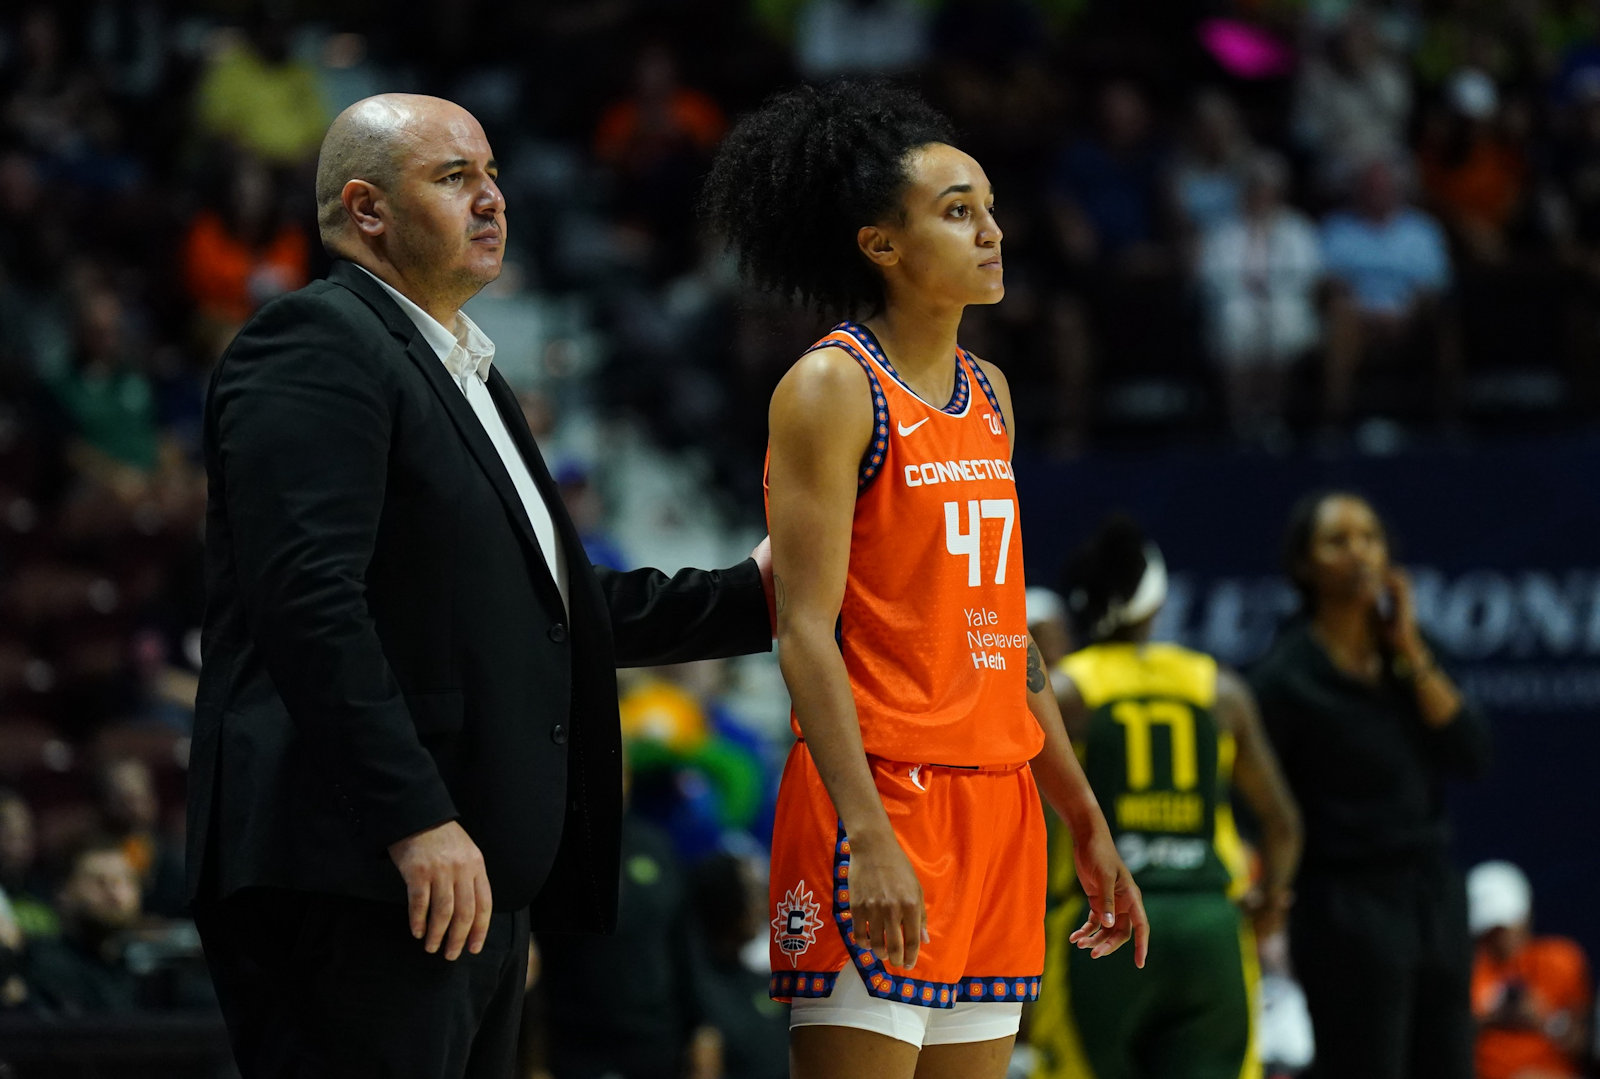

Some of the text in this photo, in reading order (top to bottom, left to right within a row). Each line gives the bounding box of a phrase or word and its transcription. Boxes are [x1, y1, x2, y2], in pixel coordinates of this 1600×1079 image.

[904, 459, 1015, 488] CONNECTICU
[944, 499, 1014, 587] 47
[963, 607, 999, 627] Yale
